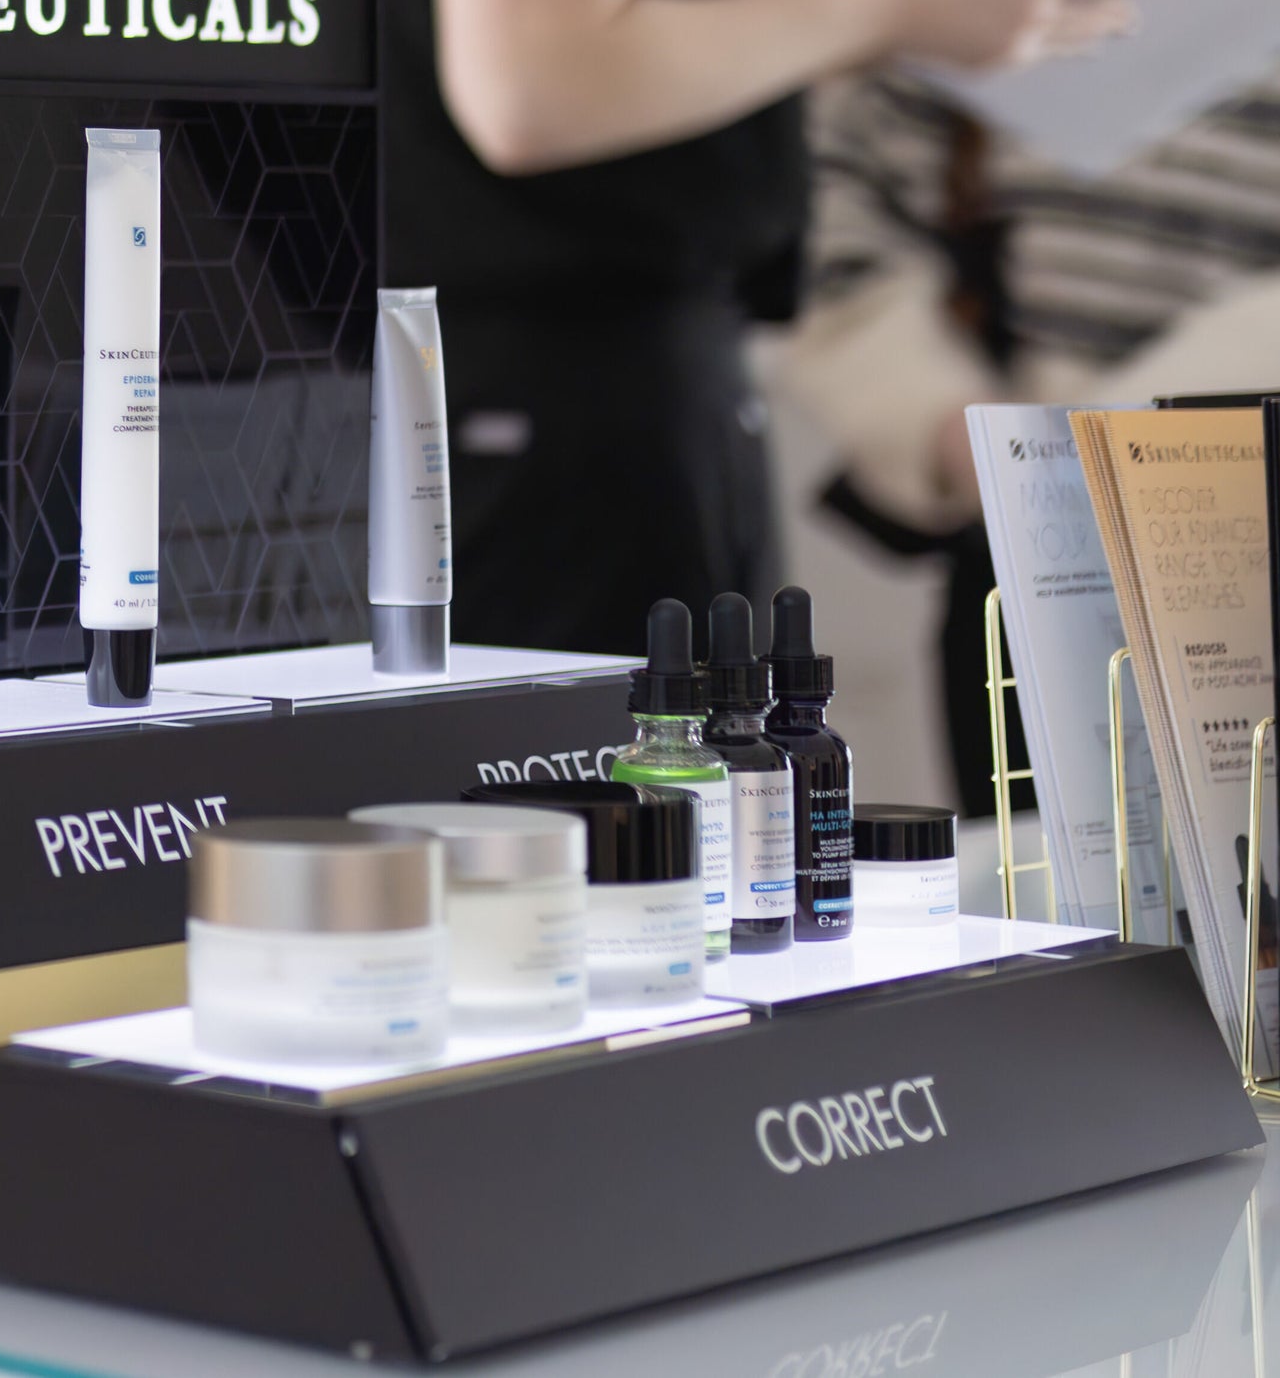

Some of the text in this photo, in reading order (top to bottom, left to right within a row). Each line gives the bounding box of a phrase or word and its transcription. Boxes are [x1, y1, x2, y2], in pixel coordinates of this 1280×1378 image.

[100, 349, 157, 359] SKINCEUT
[123, 376, 156, 384] EPIDERM
[114, 599, 126, 607] 40
[129, 599, 139, 608] ml
[810, 811, 824, 820] HA
[35, 795, 227, 878] PREVENT
[812, 852, 821, 860] TO
[755, 1076, 948, 1174] CORRECT
